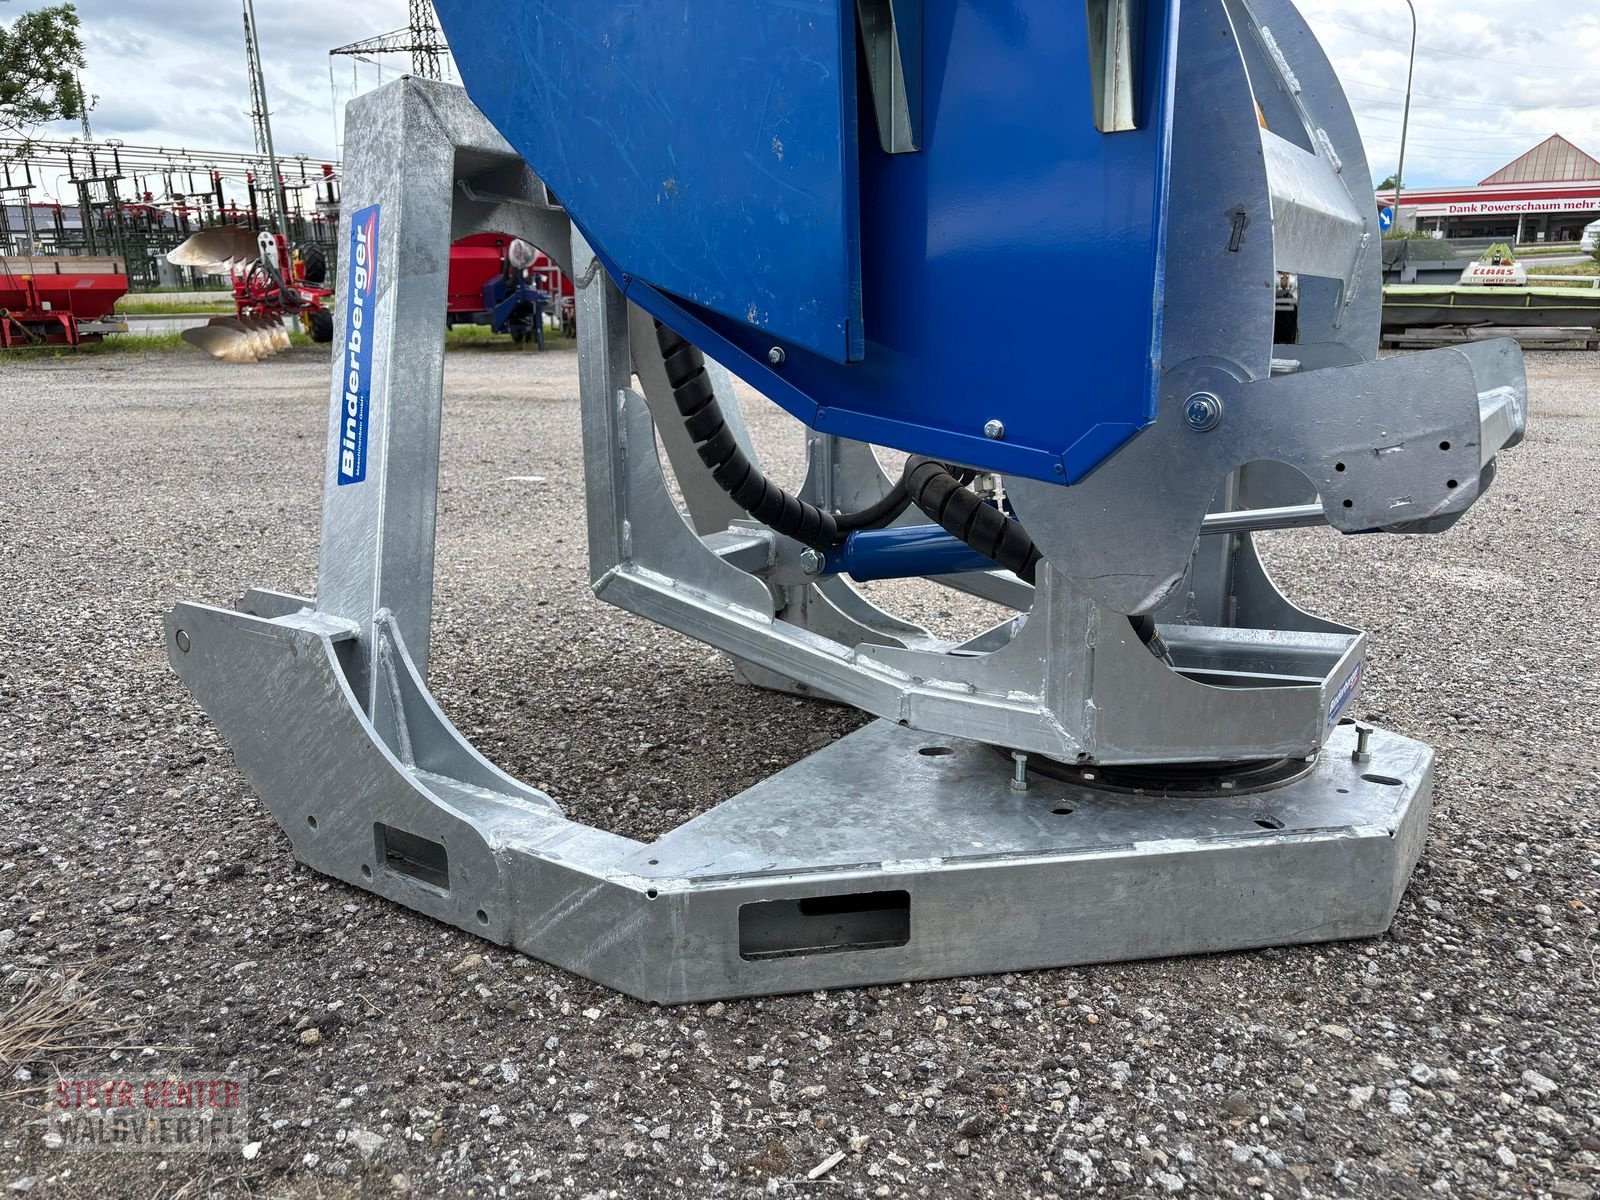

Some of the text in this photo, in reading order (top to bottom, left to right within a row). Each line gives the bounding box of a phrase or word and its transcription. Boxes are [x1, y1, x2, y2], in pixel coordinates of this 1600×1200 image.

[1449, 203, 1478, 214] Dank
[1480, 202, 1561, 212] Powerschaum
[1563, 200, 1596, 209] mehr
[1472, 268, 1514, 276] CLAAS
[341, 225, 367, 478] Binderberger
